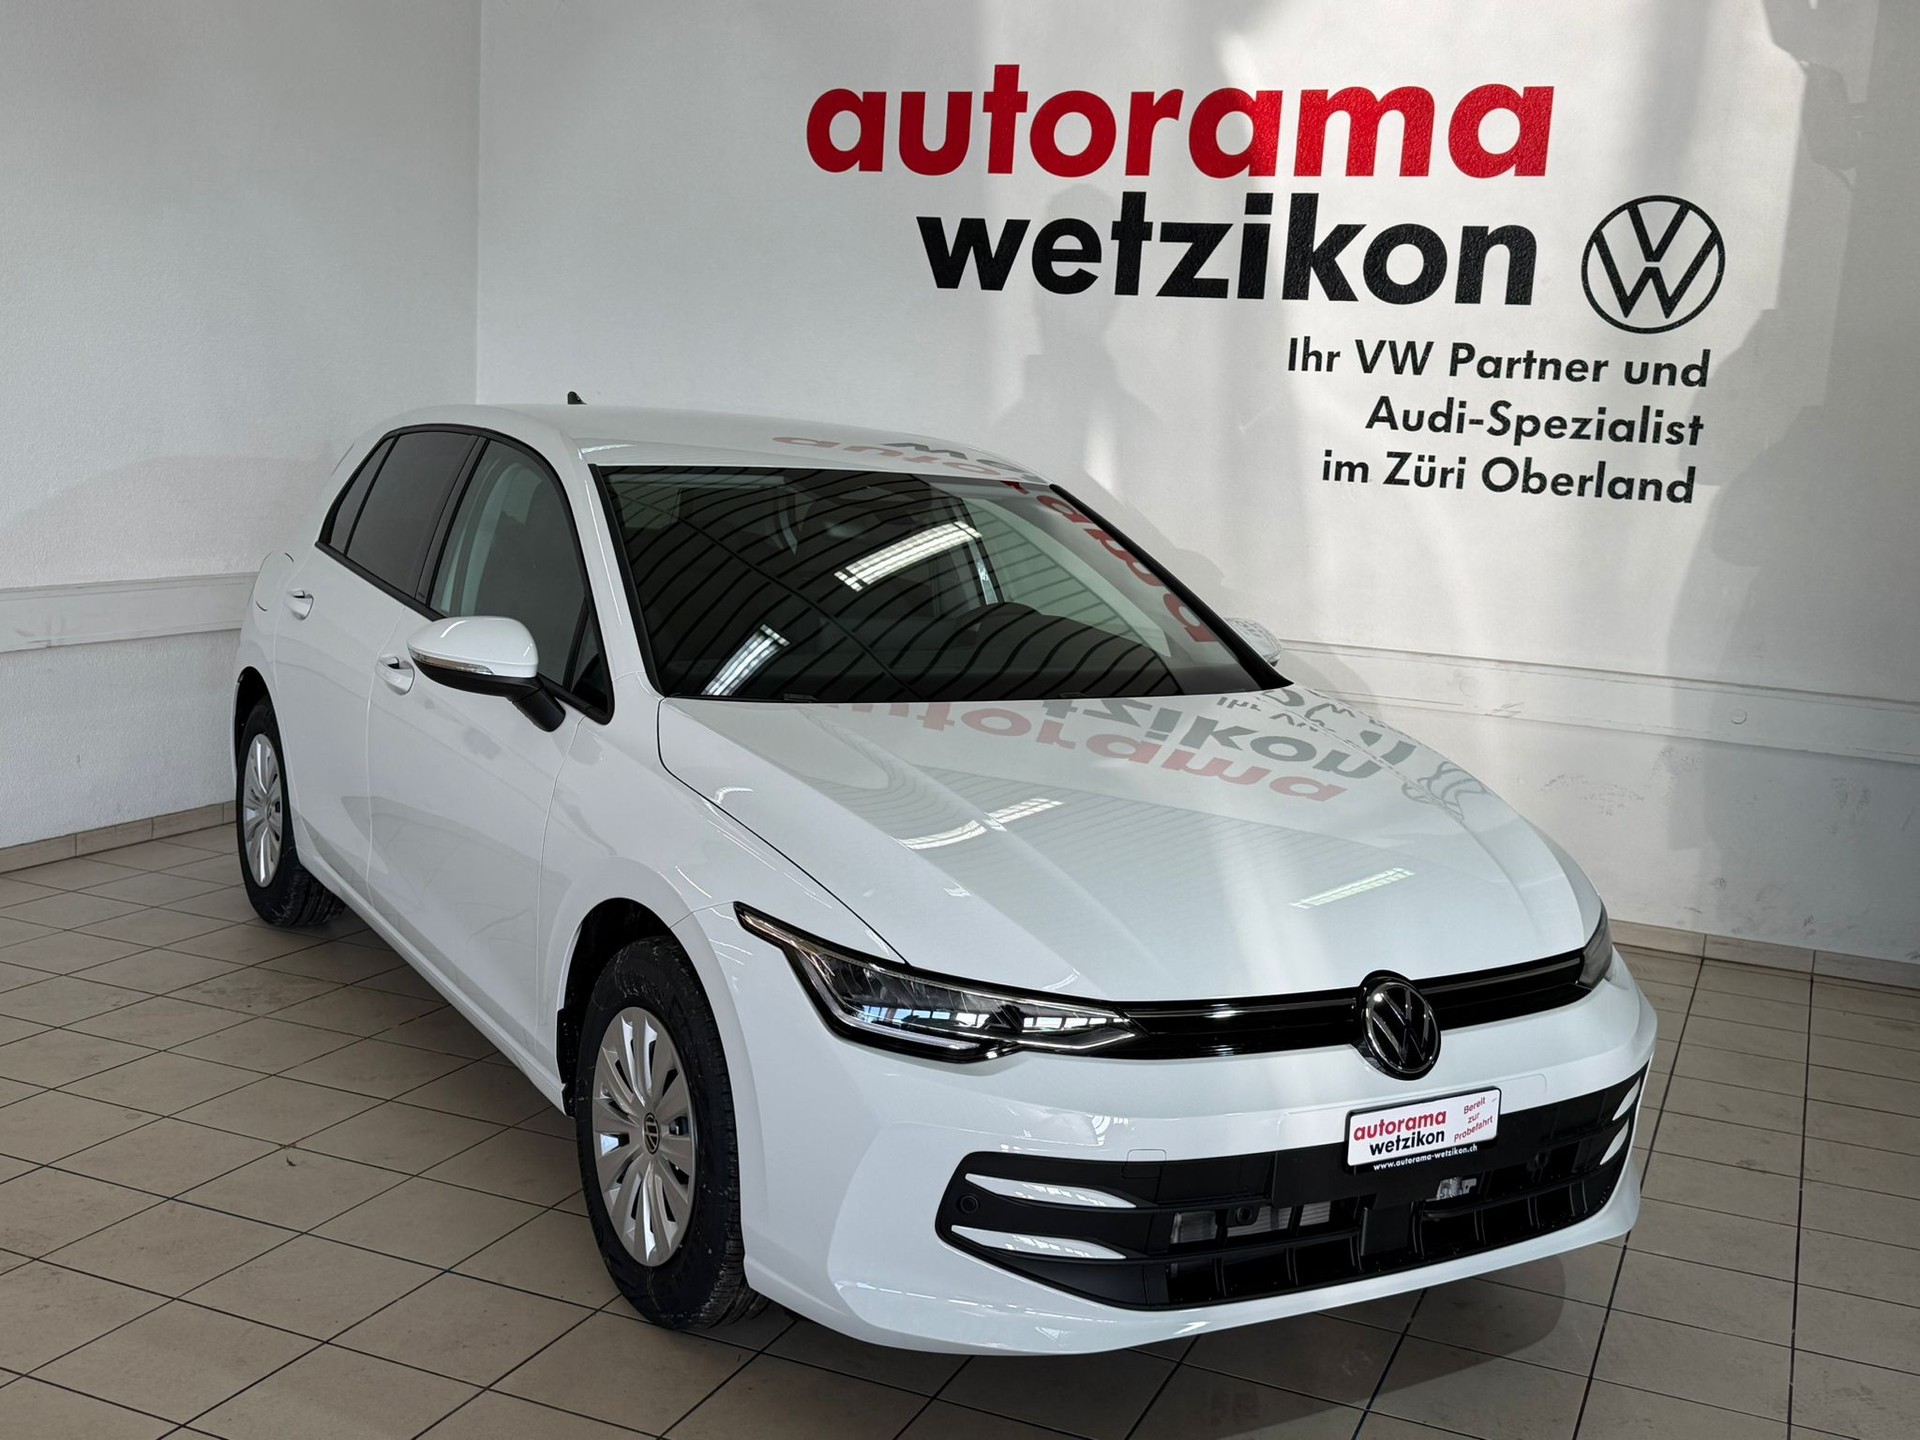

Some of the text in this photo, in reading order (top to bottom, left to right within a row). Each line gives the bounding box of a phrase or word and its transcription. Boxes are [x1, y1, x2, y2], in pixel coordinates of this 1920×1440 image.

[807, 64, 1554, 179] autorama
[915, 191, 1537, 306] wetzikon
[1287, 335, 1711, 388] Ihr VW Partner und
[1365, 395, 1705, 447] Audi-Spezialist
[1322, 449, 1697, 504] im Züri Oberland
[1463, 1097, 1486, 1115] Bereit
[1467, 1112, 1480, 1124] zur
[1353, 1111, 1447, 1141] autorama
[1454, 1115, 1493, 1143] Probefahrt
[1369, 1130, 1445, 1156] wetzikon
[1373, 1143, 1478, 1171] www.autorama-wetzikon.ch
